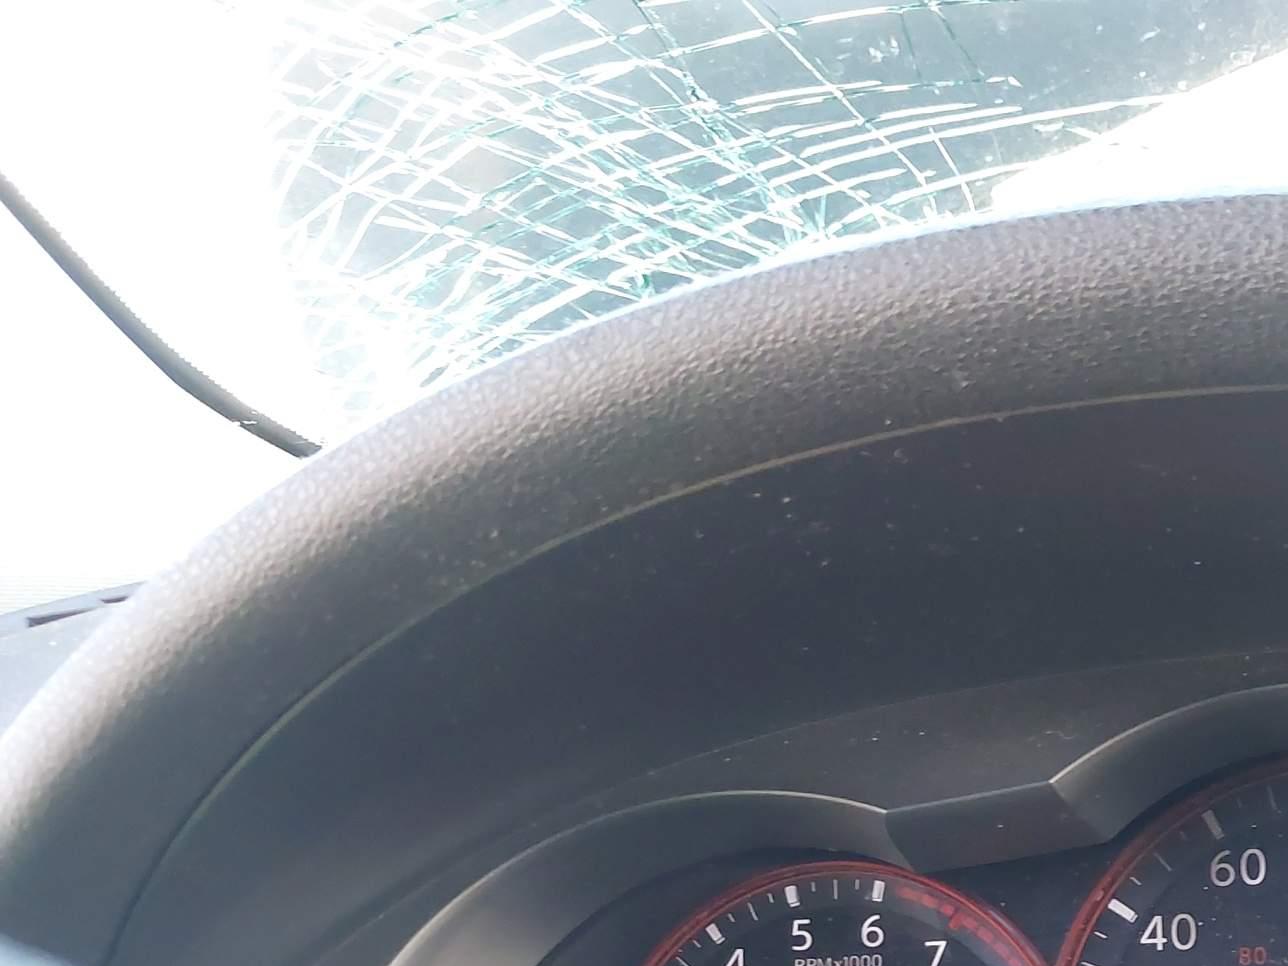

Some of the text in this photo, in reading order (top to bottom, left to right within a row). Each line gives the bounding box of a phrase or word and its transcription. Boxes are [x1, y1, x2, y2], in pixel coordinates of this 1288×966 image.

[1210, 848, 1267, 887] 60
[792, 919, 812, 951] 5
[861, 915, 884, 947] 6
[1139, 913, 1197, 950] 40
[1239, 947, 1267, 965] 80
